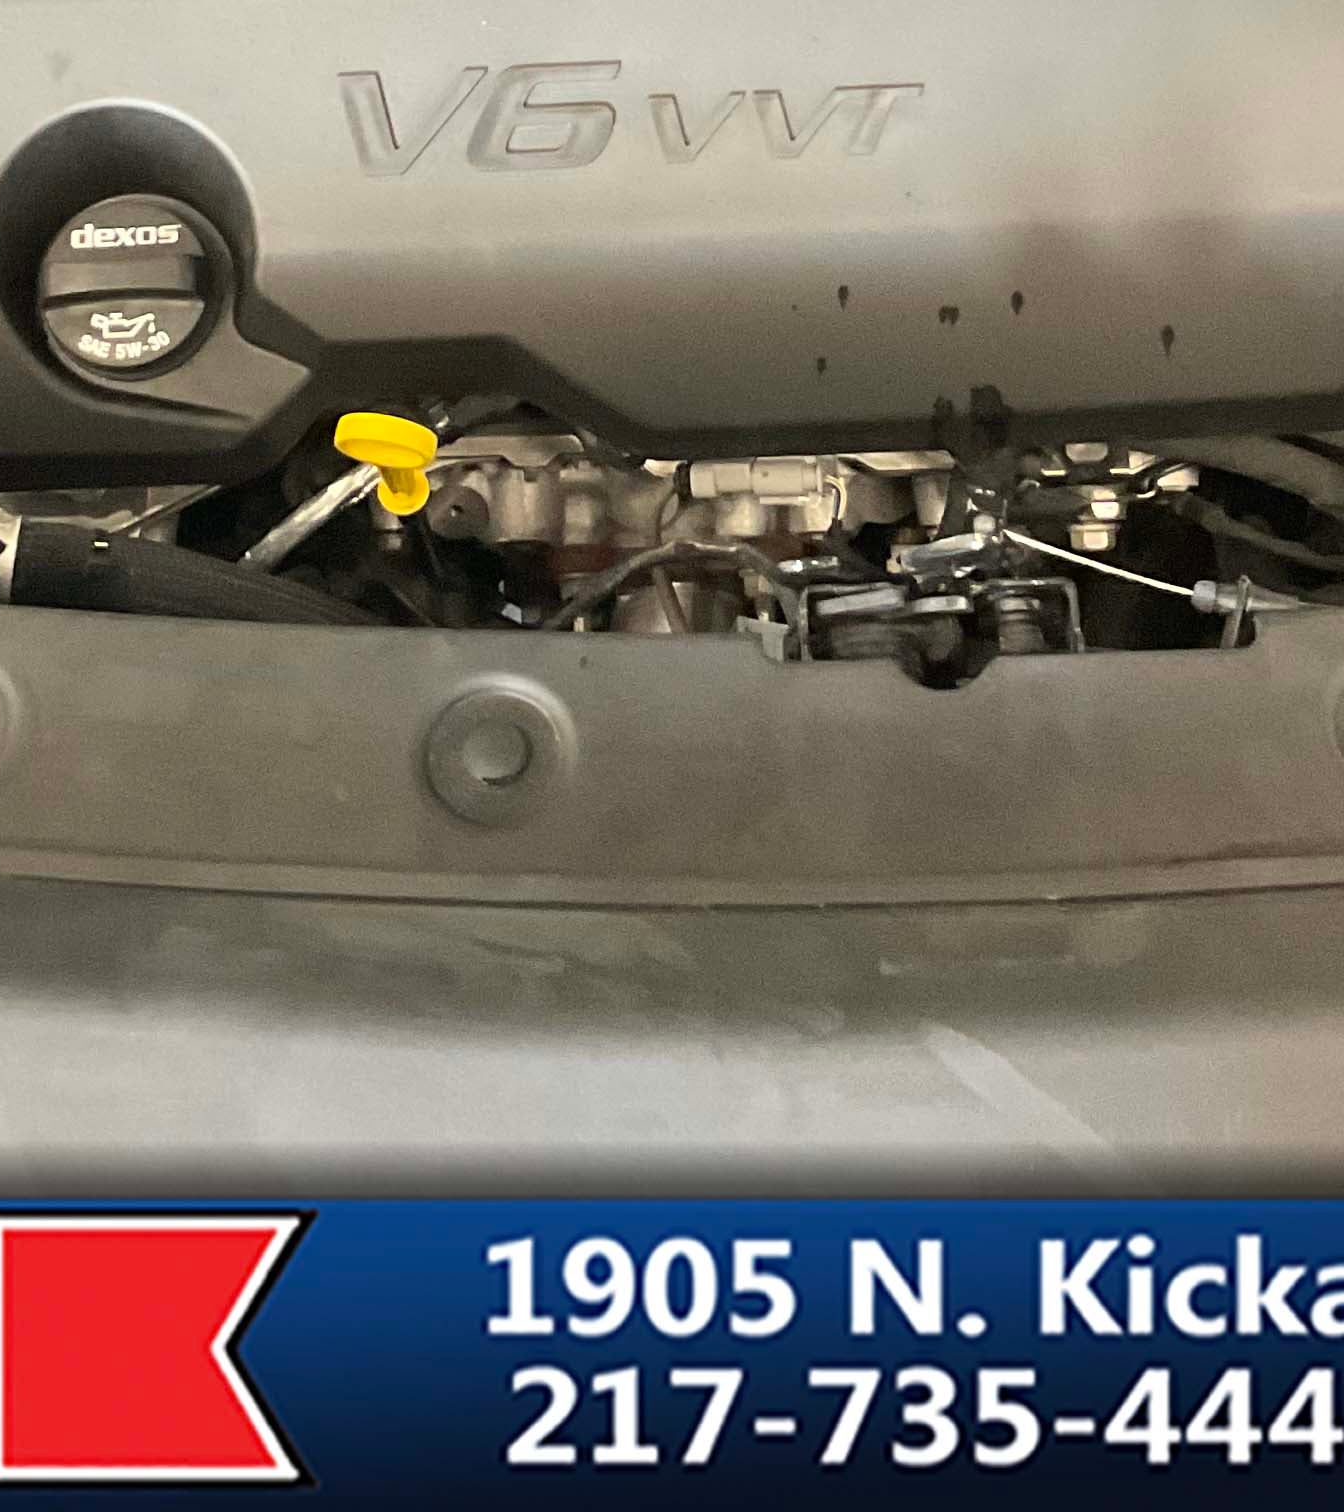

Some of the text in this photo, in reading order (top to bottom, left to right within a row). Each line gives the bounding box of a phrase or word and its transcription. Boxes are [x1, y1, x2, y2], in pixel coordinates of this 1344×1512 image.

[337, 59, 926, 176] V6 VVT
[69, 223, 179, 249] dexos
[78, 331, 170, 360] SAE 5W-30
